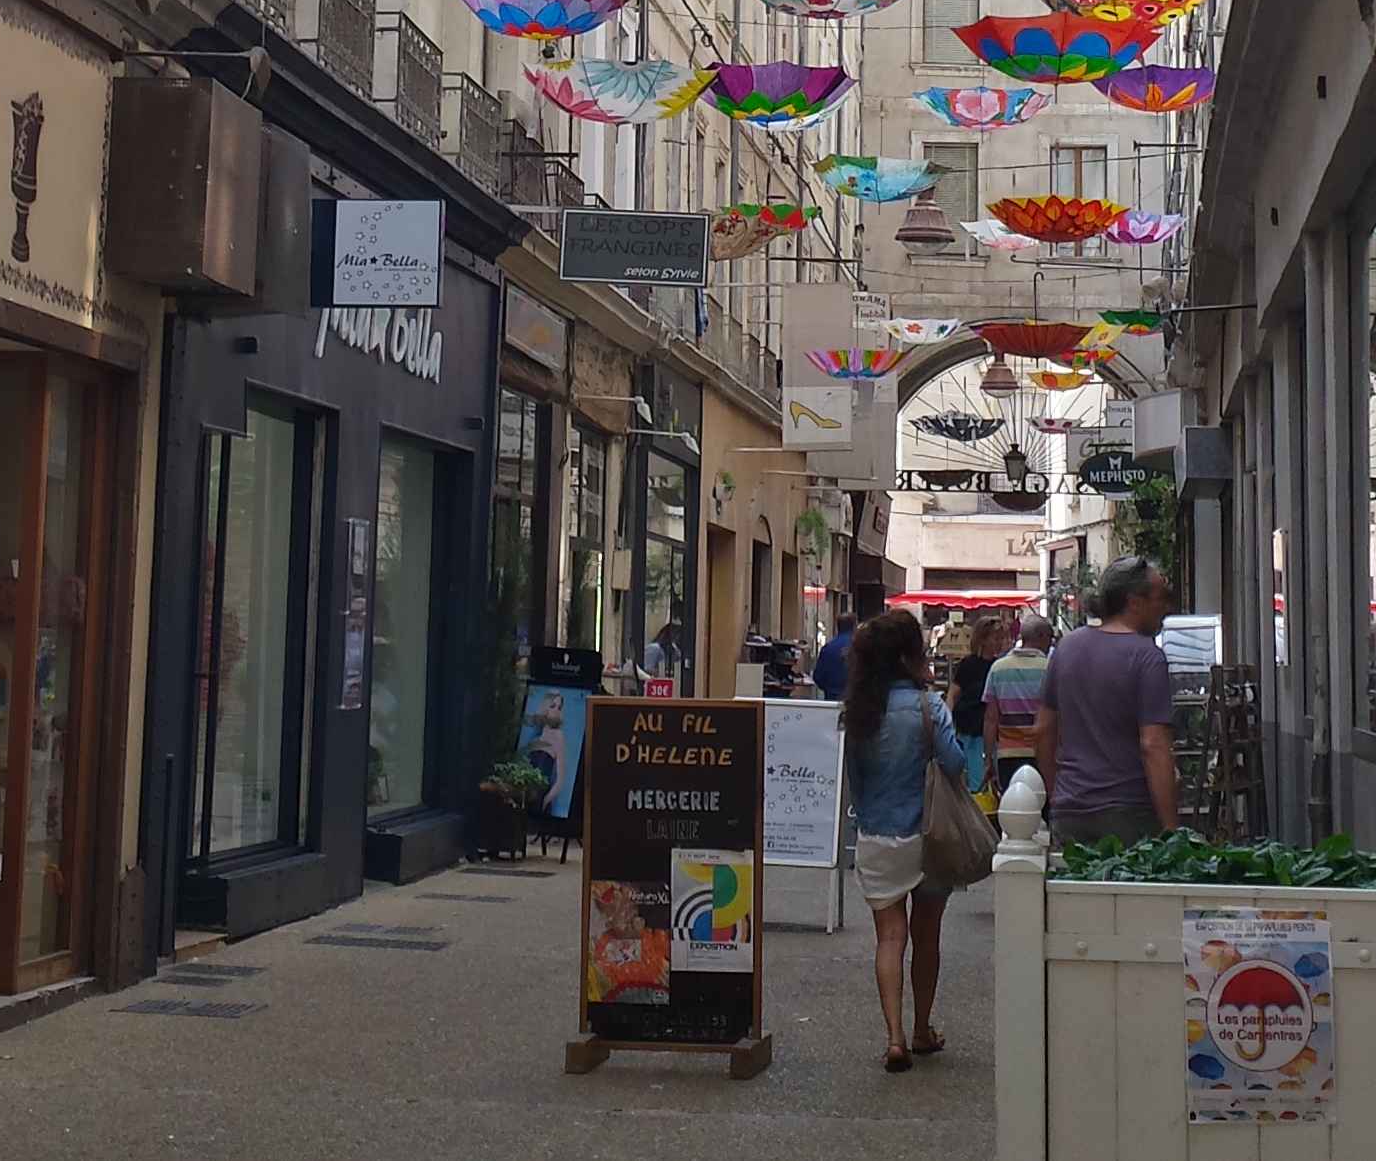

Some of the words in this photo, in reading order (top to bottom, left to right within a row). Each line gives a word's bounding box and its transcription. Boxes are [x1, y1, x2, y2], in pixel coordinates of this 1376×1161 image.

[570, 237, 701, 258] FRANGINES
[336, 252, 368, 270] Mia
[380, 253, 419, 268] Bella
[624, 266, 659, 277] selon
[1088, 469, 1146, 485] MEPHISTO
[650, 685, 669, 696] 30€
[632, 712, 664, 733] AU
[682, 713, 718, 734] FIL
[778, 764, 816, 779] Bella
[627, 789, 721, 812] MERCERIE
[689, 941, 738, 952] EXPOSITION
[1217, 1014, 1239, 1025] Les
[1218, 1029, 1234, 1041] de
